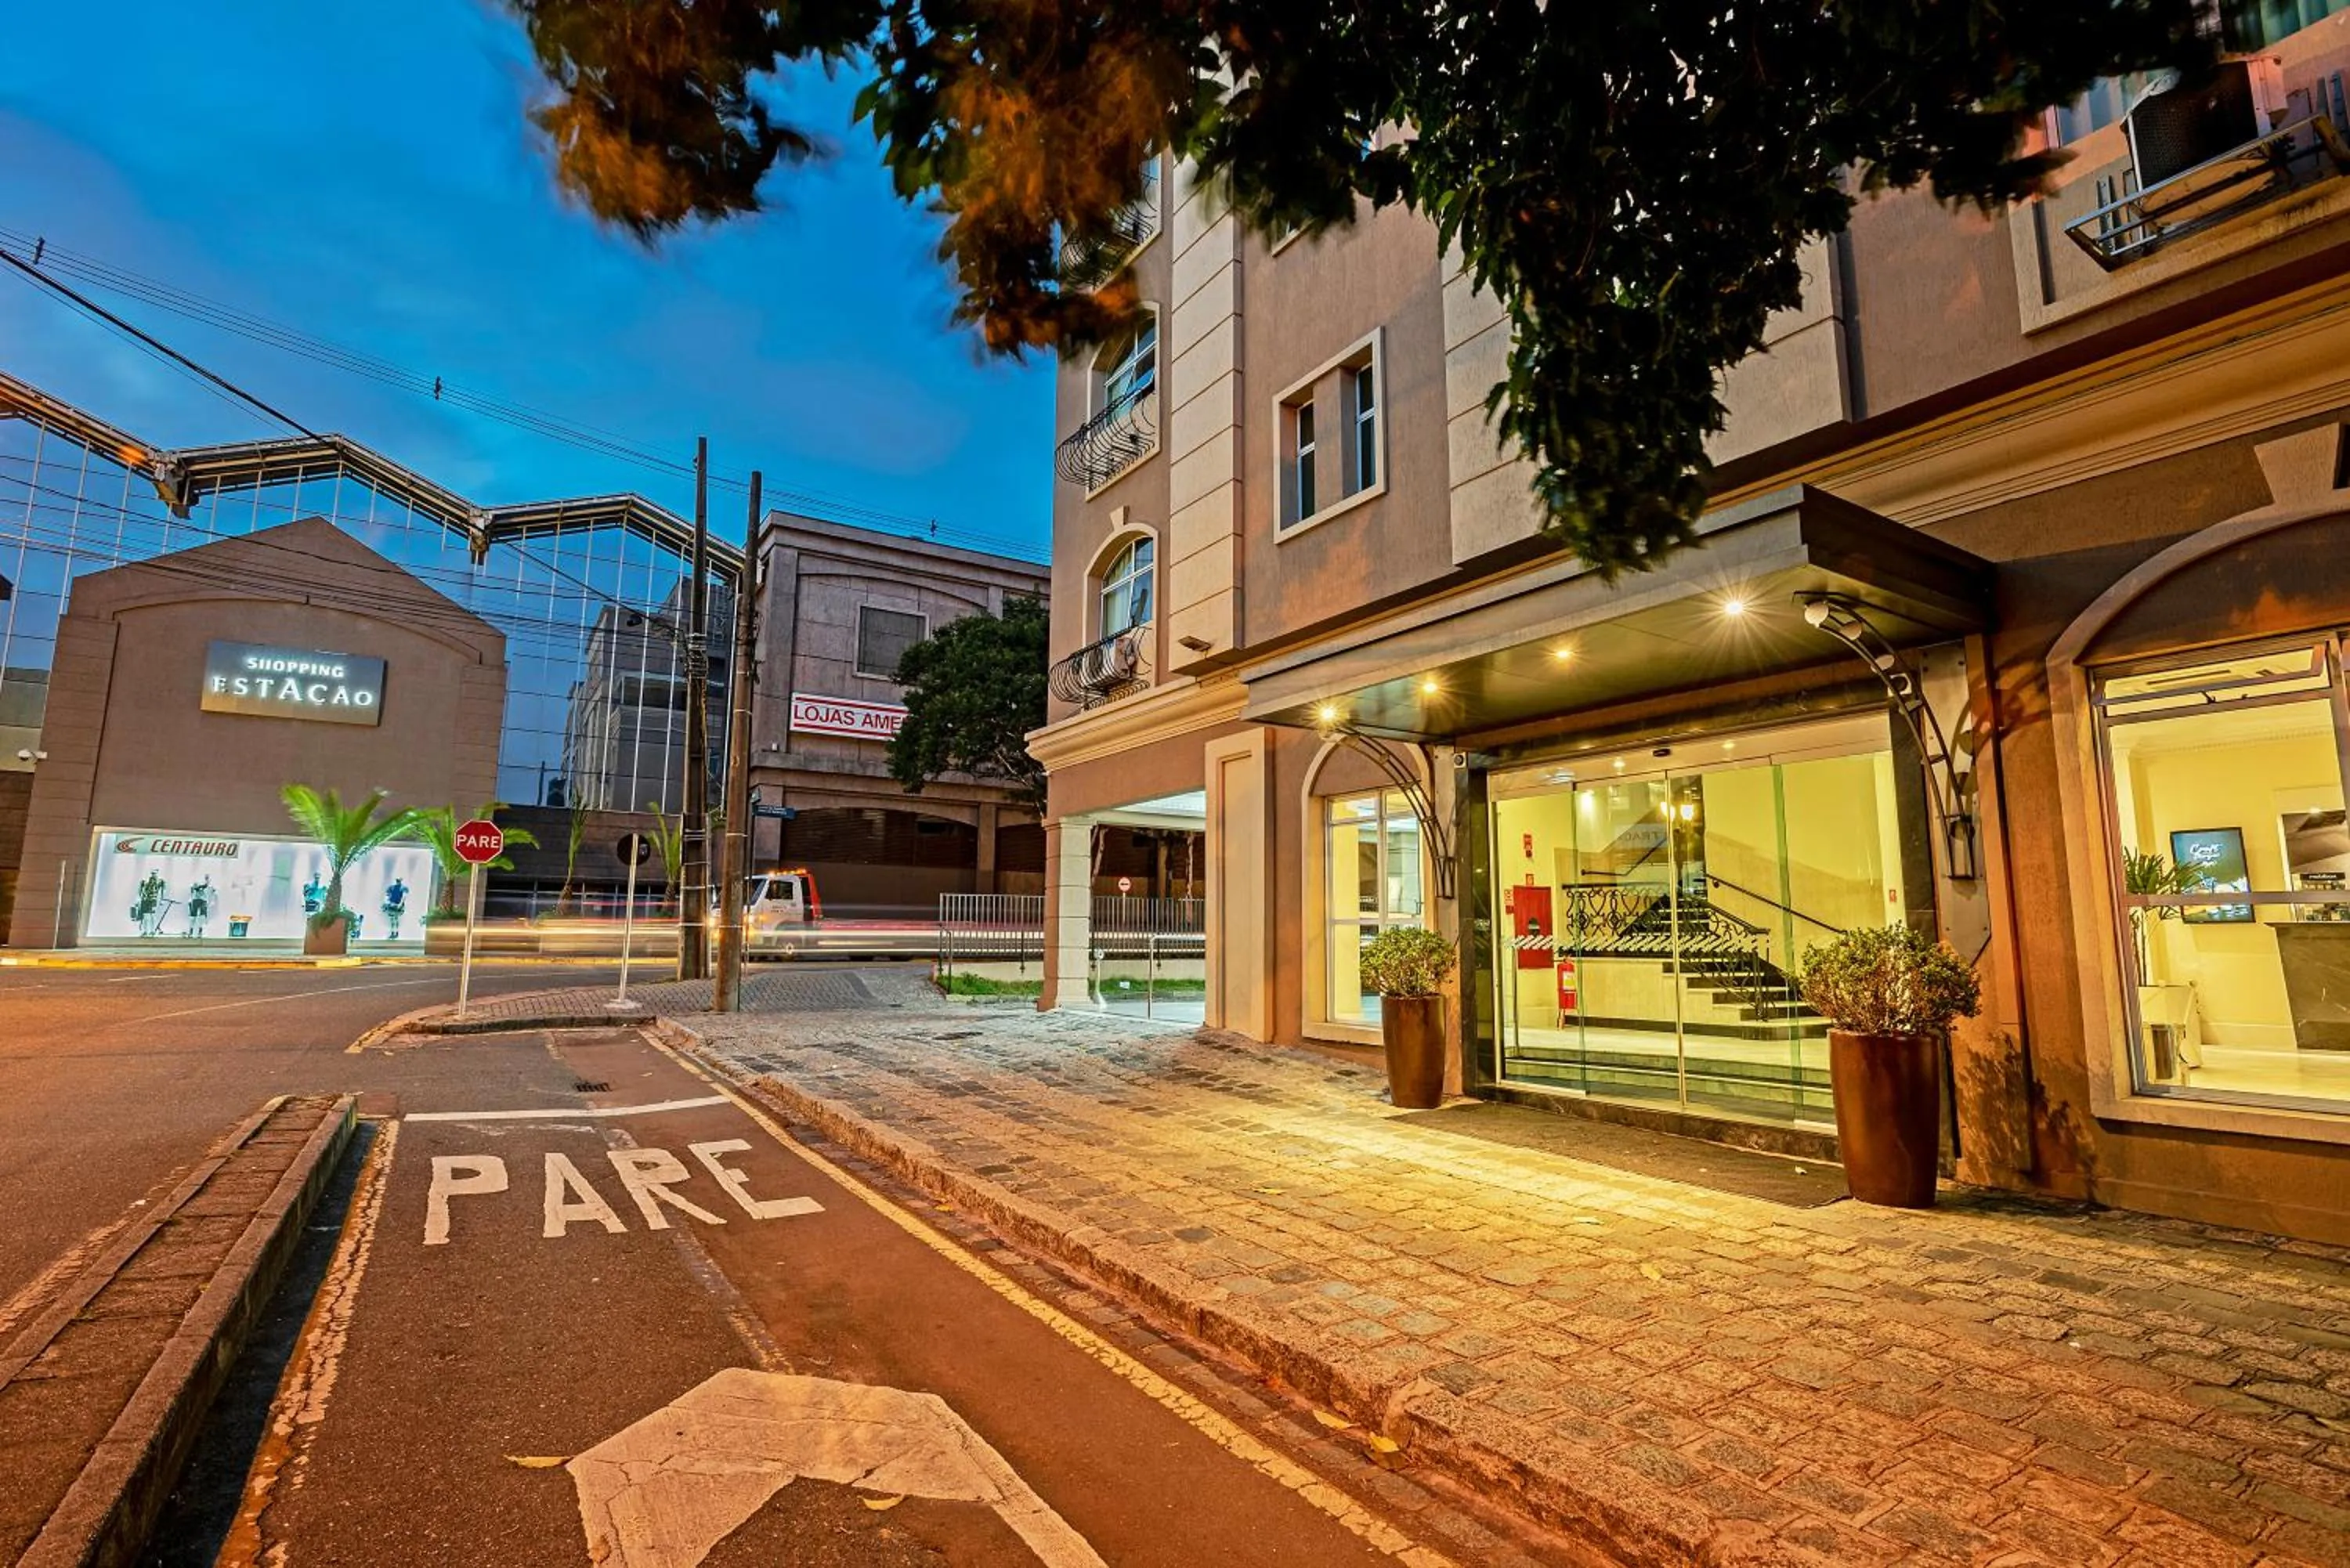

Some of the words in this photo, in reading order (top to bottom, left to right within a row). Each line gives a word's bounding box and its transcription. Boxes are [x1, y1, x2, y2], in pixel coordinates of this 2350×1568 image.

[247, 657, 345, 678] SHOPPING
[794, 704, 855, 726] LOJAS
[861, 712, 907, 731] AME
[150, 839, 237, 856] CENTAURO
[457, 834, 501, 848] PARE
[423, 1139, 826, 1245] PARE
